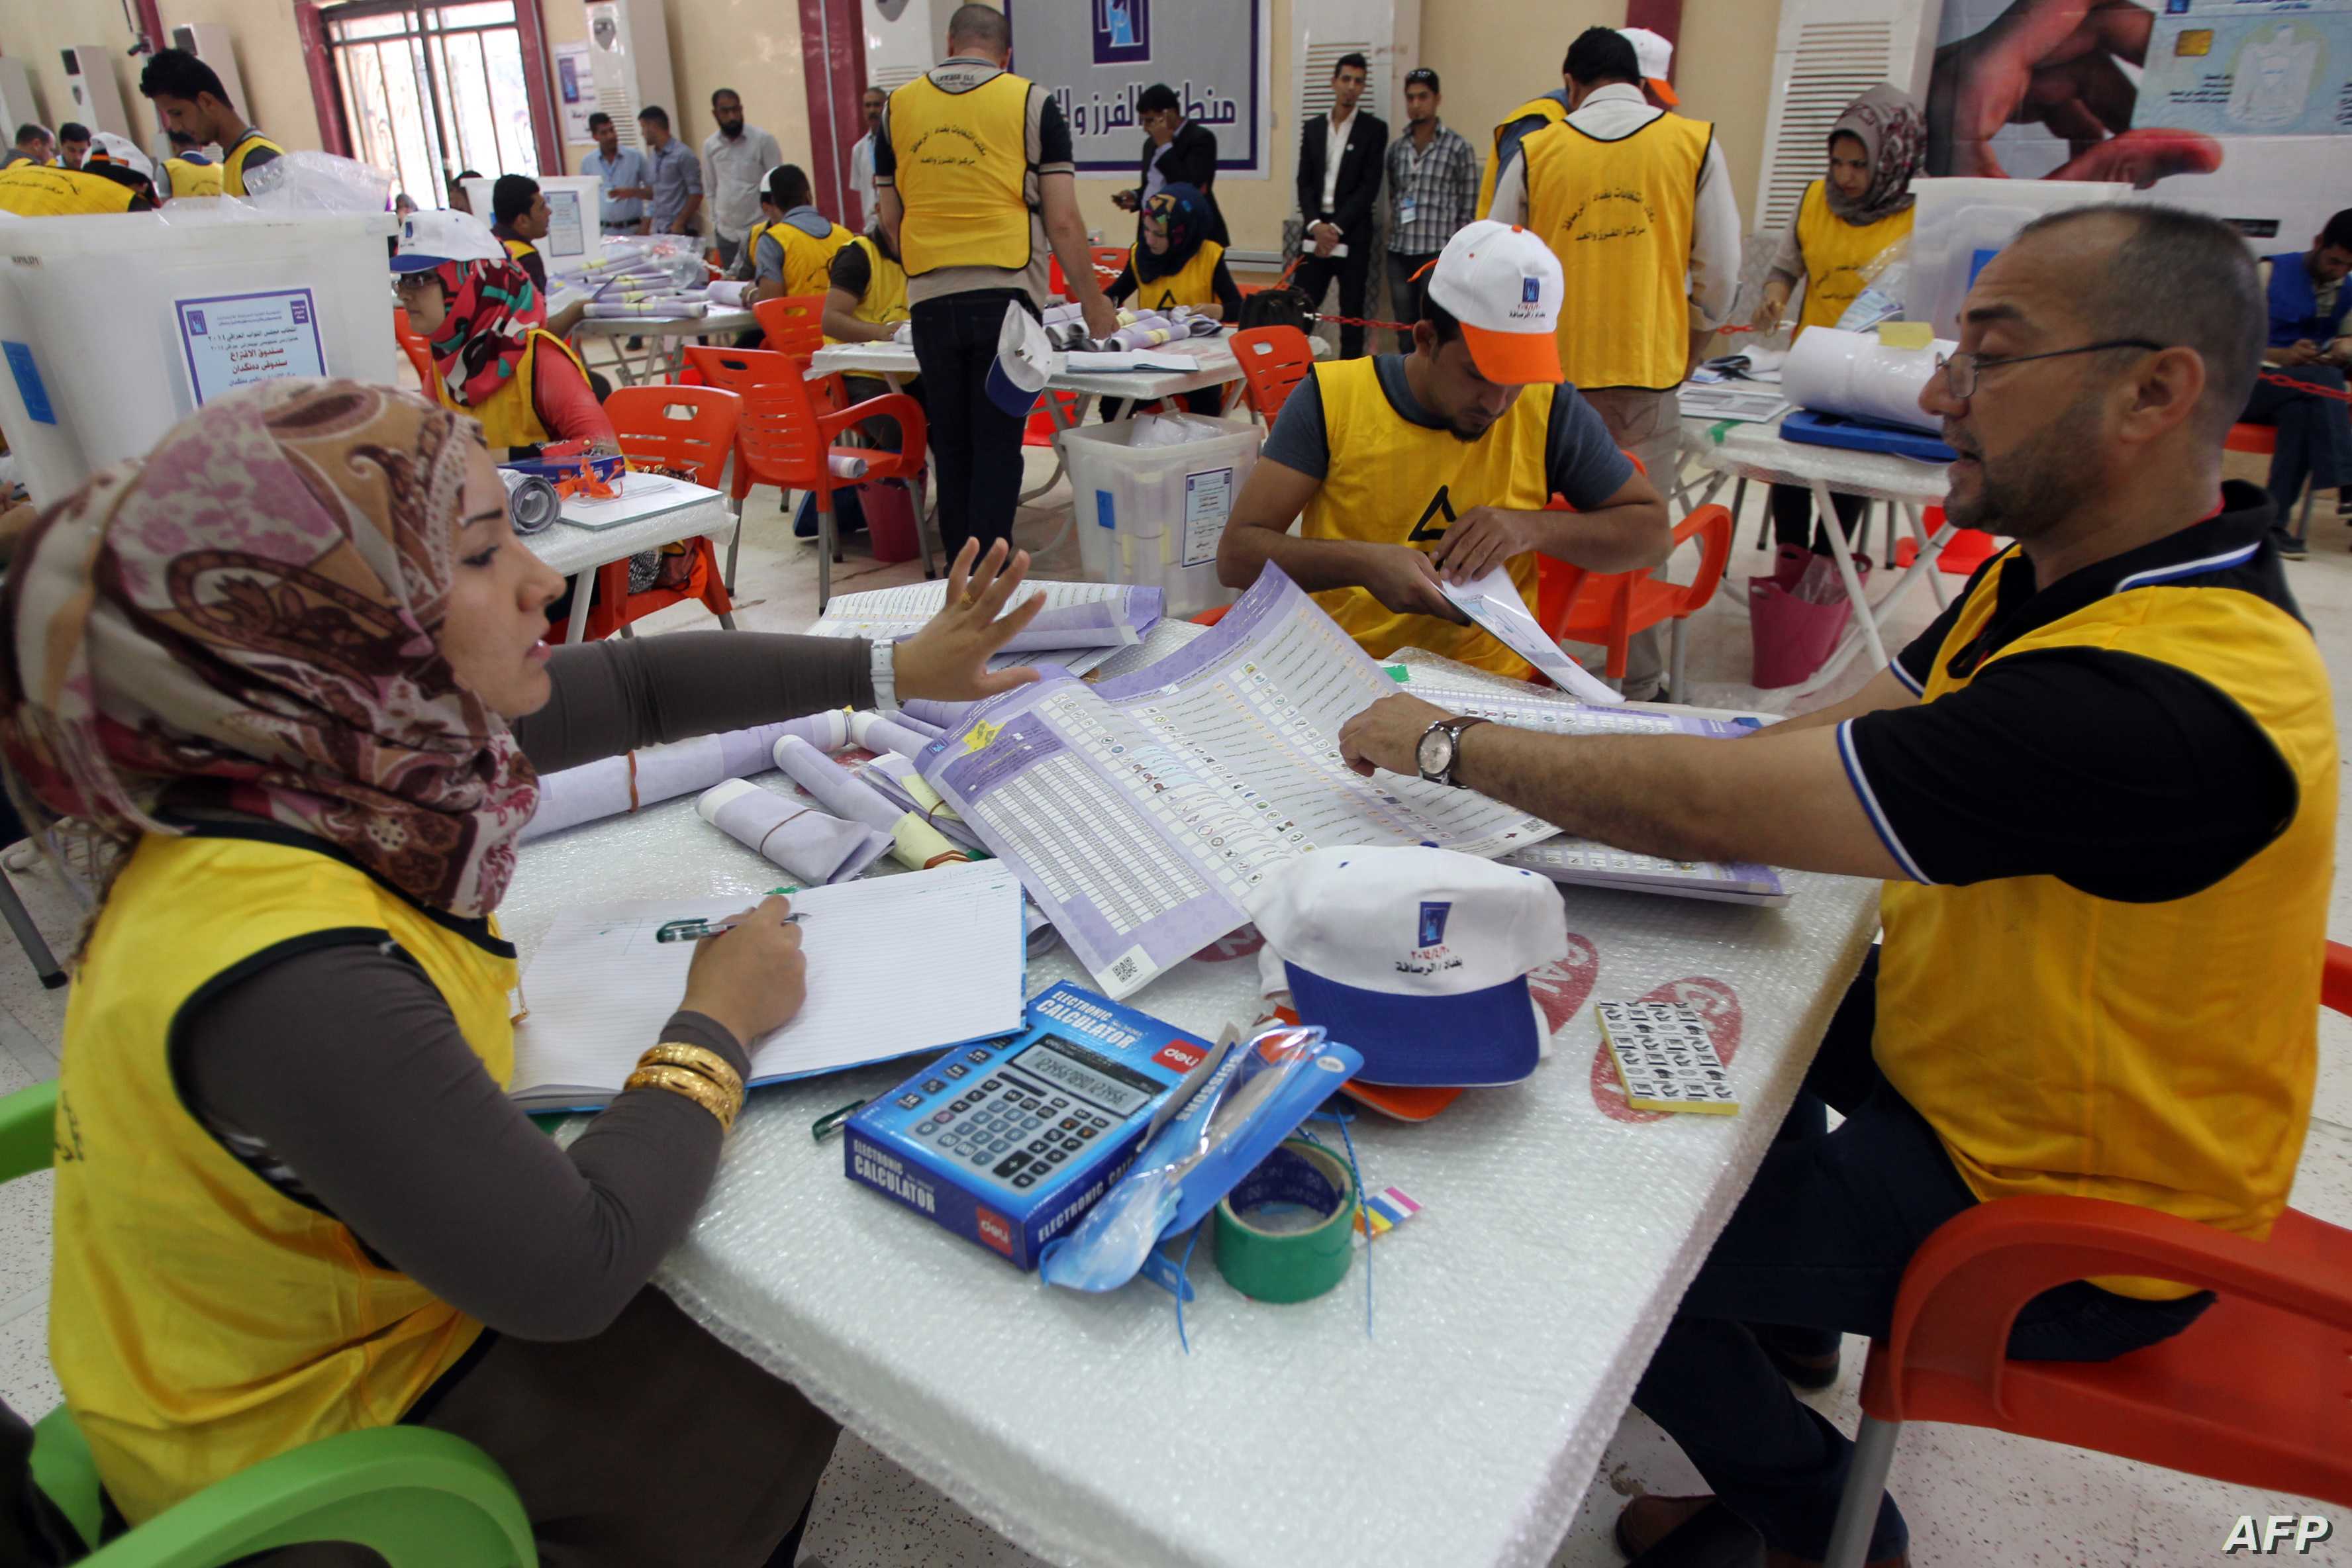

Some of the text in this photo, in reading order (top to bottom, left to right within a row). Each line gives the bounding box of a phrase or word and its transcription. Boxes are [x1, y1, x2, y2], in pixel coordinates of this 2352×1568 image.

[1176, 81, 1236, 124] منط
[1036, 999, 1136, 1050] CALCULATOR
[1052, 991, 1112, 1021] ELECTRONIC
[1163, 1048, 1200, 1067] deli
[854, 1139, 904, 1176] ELECTRONIC
[854, 1155, 936, 1213] CALCULATOR
[1038, 1181, 1104, 1244] ELECTRONIC
